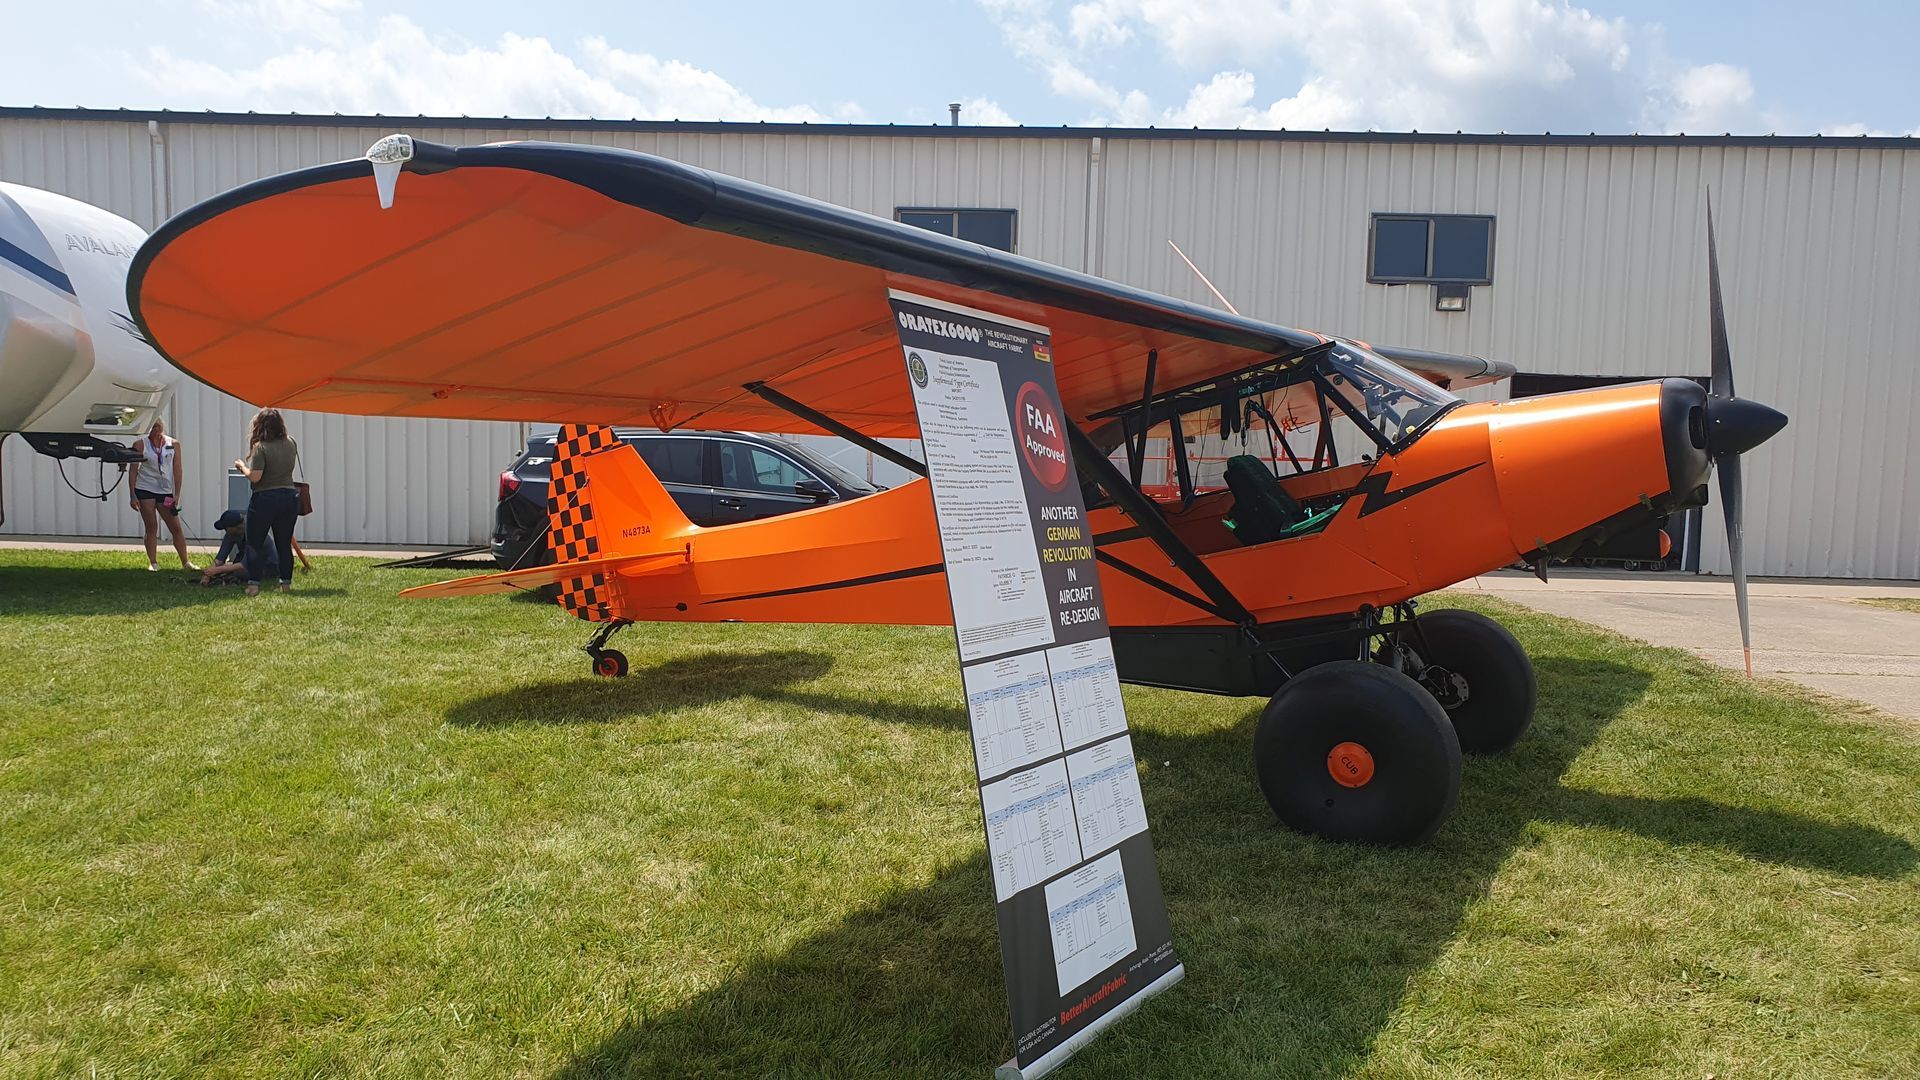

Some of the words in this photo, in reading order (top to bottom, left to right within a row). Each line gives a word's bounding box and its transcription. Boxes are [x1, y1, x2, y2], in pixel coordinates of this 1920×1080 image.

[1026, 403, 1056, 438] FAA
[1026, 434, 1066, 464] Approved
[1041, 506, 1079, 520] ANOTHER
[622, 525, 651, 538] N4873A
[1046, 526, 1081, 541] GERMAN
[1043, 546, 1091, 563] REVOLUTION
[1067, 567, 1077, 582] IN
[1059, 586, 1093, 604] AIRCRAFT
[1060, 606, 1100, 627] RE-DESIGN
[1341, 756, 1359, 775] CUB
[1060, 973, 1127, 1025] BetterAircraftFabric
